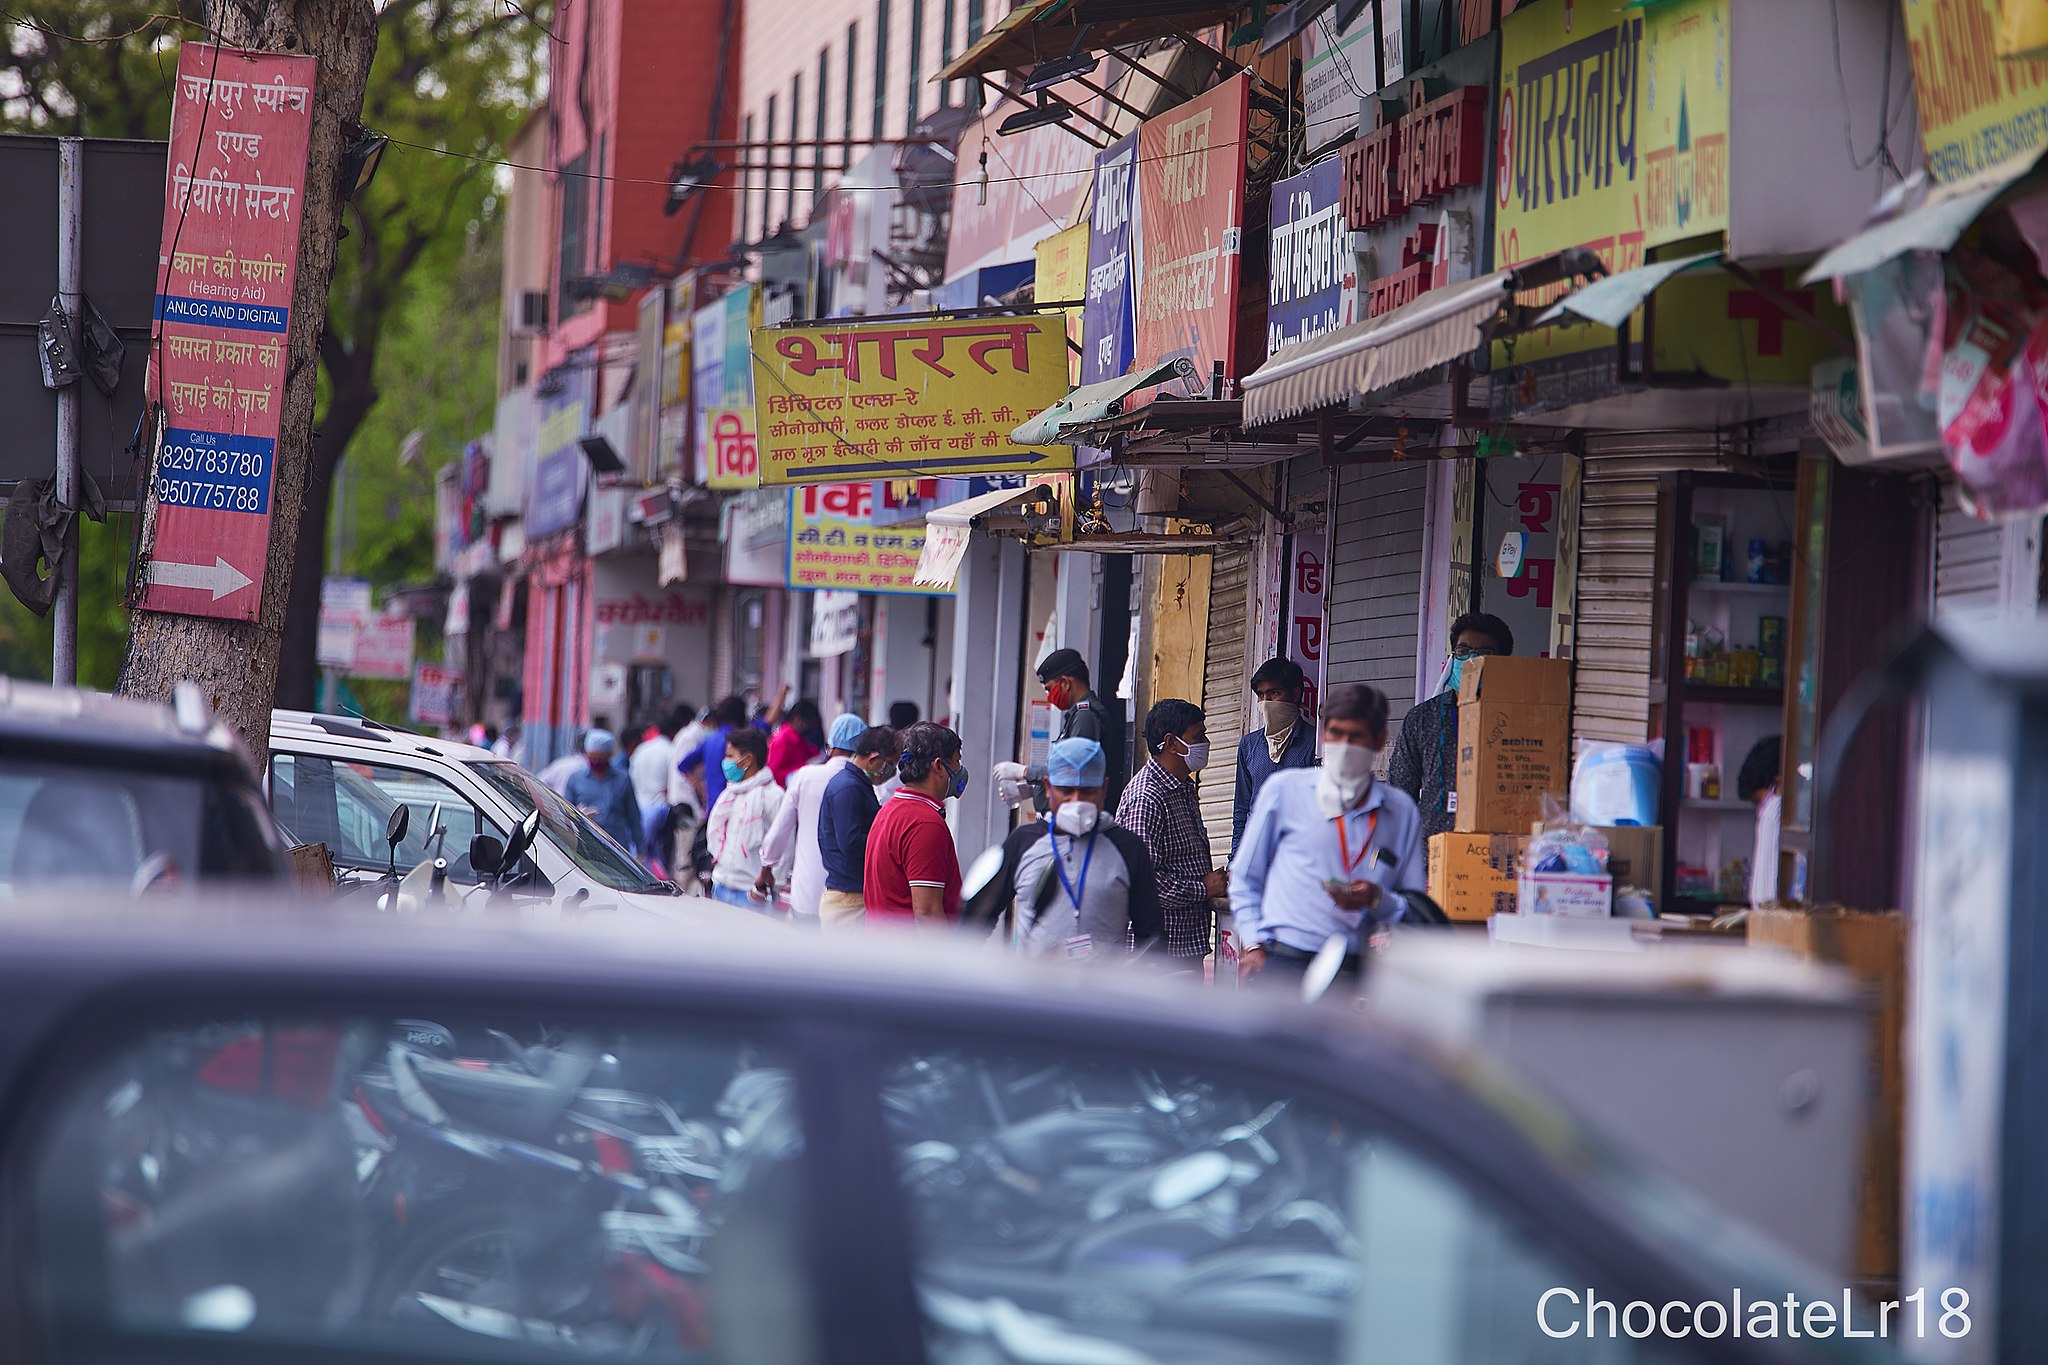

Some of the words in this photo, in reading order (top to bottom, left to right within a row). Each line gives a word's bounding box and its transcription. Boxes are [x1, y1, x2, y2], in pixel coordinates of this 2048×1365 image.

[182, 74, 247, 120] जयपुर
[252, 75, 309, 114] स्पीच
[216, 131, 262, 163] एण्ड
[1163, 107, 1212, 207] भारत
[1340, 100, 1393, 233] महावीर
[172, 163, 241, 217] हियरिंग
[245, 171, 295, 222] सेन्टर
[1096, 148, 1132, 236] भारत
[1271, 192, 1294, 307] शर्मा
[1293, 190, 1332, 299] मेडिकल
[172, 252, 209, 277] कान
[212, 250, 237, 279] की
[240, 253, 287, 284] मशीन
[189, 280, 239, 300] (Hearing
[241, 285, 266, 301] Aid)
[166, 300, 208, 316] ANLOG
[210, 303, 235, 320] AND
[238, 307, 282, 325] DIGITAL
[169, 335, 213, 362] समस्त
[214, 340, 256, 366] प्रकार
[258, 337, 281, 368] की
[775, 323, 1042, 384] भारत
[170, 376, 209, 414] सुनाई
[211, 378, 234, 411] की
[768, 393, 844, 415] डिजिटल
[190, 432, 205, 444] Call
[205, 434, 217, 445] Us
[855, 417, 890, 432] कलर
[895, 413, 937, 430] डोप्लर
[771, 447, 797, 461] मल
[801, 445, 829, 464] मूत्र
[885, 436, 905, 453] की
[909, 434, 943, 452] जाँच
[947, 432, 975, 450] यहाँ
[980, 430, 1000, 448] की
